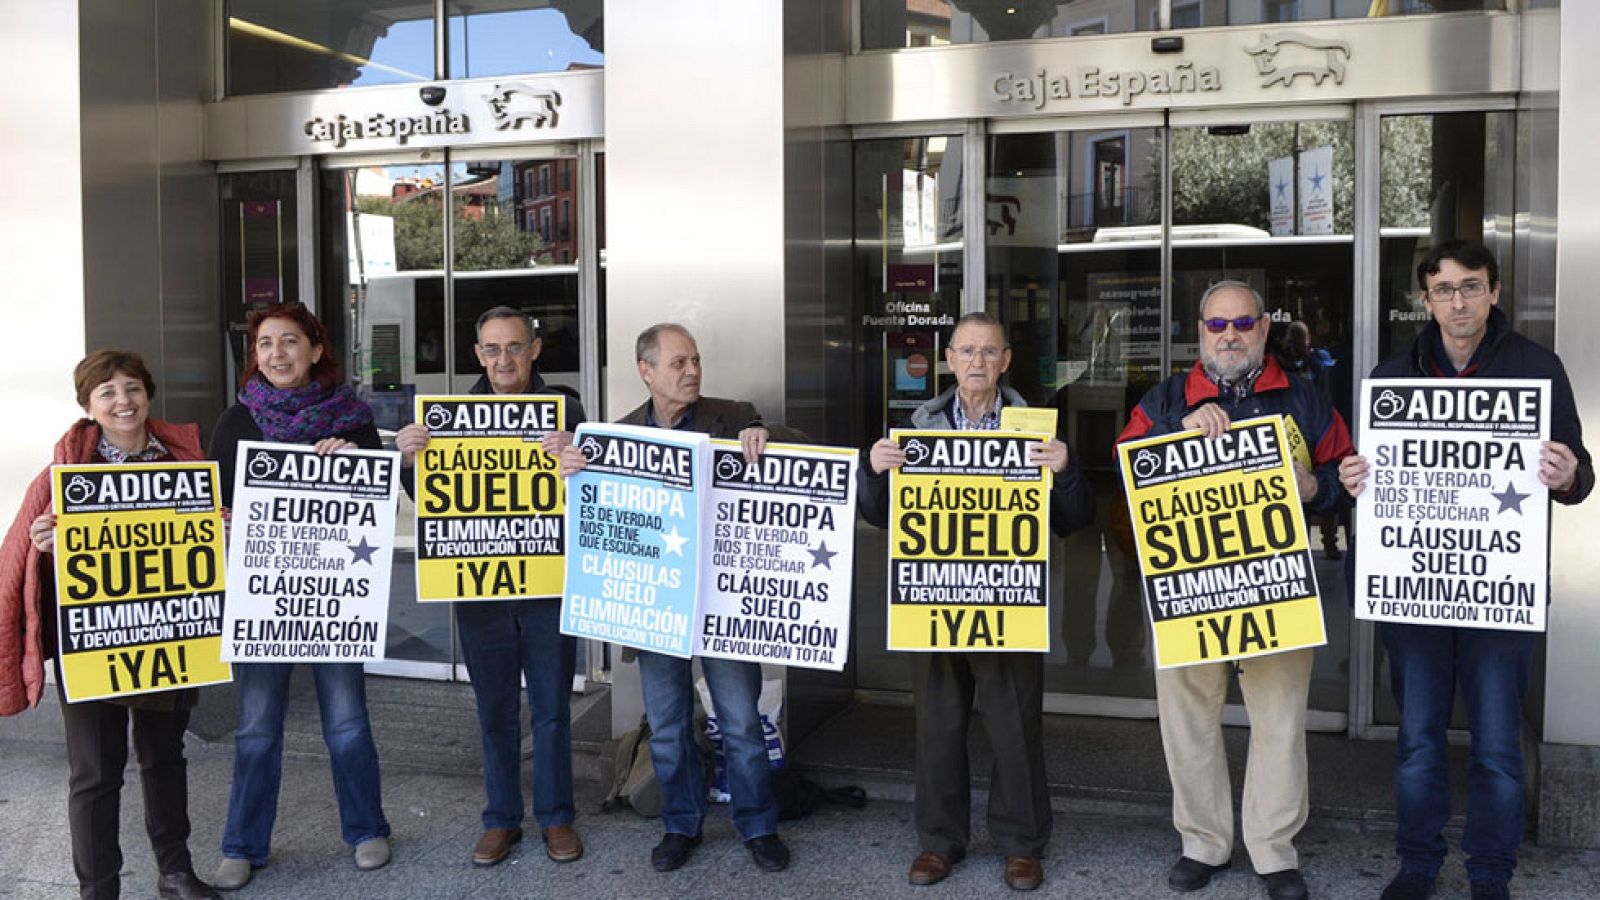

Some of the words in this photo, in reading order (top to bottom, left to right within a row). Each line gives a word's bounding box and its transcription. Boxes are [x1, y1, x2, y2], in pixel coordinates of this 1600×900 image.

[993, 68, 1071, 109] Caja
[1078, 61, 1222, 106] España
[364, 109, 471, 145] España
[862, 315, 906, 326] Fuente
[907, 313, 955, 326] Dorada
[885, 301, 931, 313] Oficina
[453, 403, 556, 429] ADICAE
[1406, 389, 1537, 422] ADICAE
[425, 443, 556, 472] CLÁUSULAS
[603, 439, 690, 478] ADICAE
[1164, 425, 1278, 474] ADICAE
[1375, 444, 1397, 468] SI
[1402, 439, 1526, 471] EUROPA
[278, 454, 390, 486] ADICAE
[743, 457, 848, 491] ADICAE
[1375, 470, 1395, 485] ES
[1399, 471, 1420, 486] DE
[1424, 472, 1496, 490] VERDAD,
[98, 471, 211, 503] ADICAE
[424, 472, 557, 514] SUELO
[581, 484, 597, 504] SI
[600, 481, 685, 519] EUROPA
[899, 480, 1041, 512] CLÁUSULAS
[1140, 475, 1287, 525] CLÁUSULAS
[1374, 487, 1409, 503] NOS
[1413, 488, 1459, 505] TIENE
[249, 501, 268, 522] SI
[272, 497, 377, 527] EUROPA
[425, 513, 560, 542] ELIMINACIÓN
[580, 505, 596, 520] ES
[598, 507, 613, 523] DE
[615, 509, 665, 532] VERDAD,
[716, 501, 734, 522] SI
[737, 498, 835, 532] EUROPA
[1374, 503, 1404, 519] QUE
[1407, 505, 1490, 522] ESCUCHAR
[65, 518, 215, 553] CLÁUSULAS
[246, 523, 265, 539] ES
[269, 525, 287, 540] DE
[291, 526, 351, 543] VERDAD,
[425, 543, 435, 557] Y
[438, 538, 517, 557] DEVOLUCIÓN
[518, 540, 560, 553] TOTAL
[579, 520, 604, 536] NOS
[607, 523, 640, 543] TIENE
[579, 533, 601, 550] QUE
[603, 538, 660, 559] ESCUCHAR
[714, 523, 731, 538] ES
[735, 525, 751, 540] DE
[754, 527, 811, 548] VERDAD,
[899, 512, 1040, 557] SUELO
[1146, 502, 1296, 570] SUELO
[1381, 521, 1521, 553] CLÁUSULAS
[244, 555, 271, 569] QUE
[274, 556, 345, 571] ESCUCHAR
[245, 540, 276, 555] NOS
[280, 541, 320, 556] TIENE
[713, 538, 741, 554] NOS
[745, 541, 782, 558] TIENE
[713, 553, 737, 568] QUE
[740, 555, 805, 574] ESCUCHAR
[1411, 552, 1487, 576] SUELO
[66, 545, 216, 600] SUELO
[248, 569, 370, 597] CLÁUSULAS
[456, 560, 527, 597] ¡YA!
[582, 553, 681, 589] CLÁUSULAS
[717, 569, 829, 602] CLÁUSULAS
[898, 558, 1041, 588] ELIMINACIÓN
[1153, 551, 1306, 601] ELIMINACIÓN
[602, 579, 656, 607] SUELO
[898, 587, 908, 601] Y
[910, 584, 996, 602] DEVOLUCIÓN
[998, 588, 1041, 604] TOTAL
[1158, 602, 1168, 618] Y
[1172, 586, 1259, 616] DEVOLUCIÓN
[1261, 580, 1309, 603] TOTAL
[1367, 574, 1535, 607] ELIMINACIÓN
[67, 590, 220, 633] ELIMINACIÓN
[274, 597, 340, 618] SUELO
[570, 594, 688, 637] ELIMINACIÓN
[740, 598, 801, 620] SUELO
[1367, 600, 1377, 615] Y
[1380, 600, 1478, 622] DEVOLUCIÓN
[1483, 606, 1534, 625] TOTAL
[69, 635, 81, 649] Y
[84, 624, 174, 649] DEVOLUCIÓN
[176, 619, 221, 639] TOTAL
[233, 615, 378, 643] ELIMINACIÓN
[568, 616, 577, 631] Y
[578, 617, 647, 645] DEVOLUCIÓN
[650, 631, 685, 651] TOTAL
[703, 614, 838, 649] ELIMINACIÓN
[930, 609, 1005, 647] ¡YA!
[1195, 608, 1279, 659] ¡YA!
[232, 643, 241, 657] Y
[244, 641, 331, 658] DEVOLUCIÓN
[334, 644, 375, 658] TOTAL
[702, 637, 711, 651] Y
[713, 637, 792, 660] DEVOLUCIÓN
[795, 646, 835, 664] TOTAL
[107, 644, 189, 692] ¡YA!
